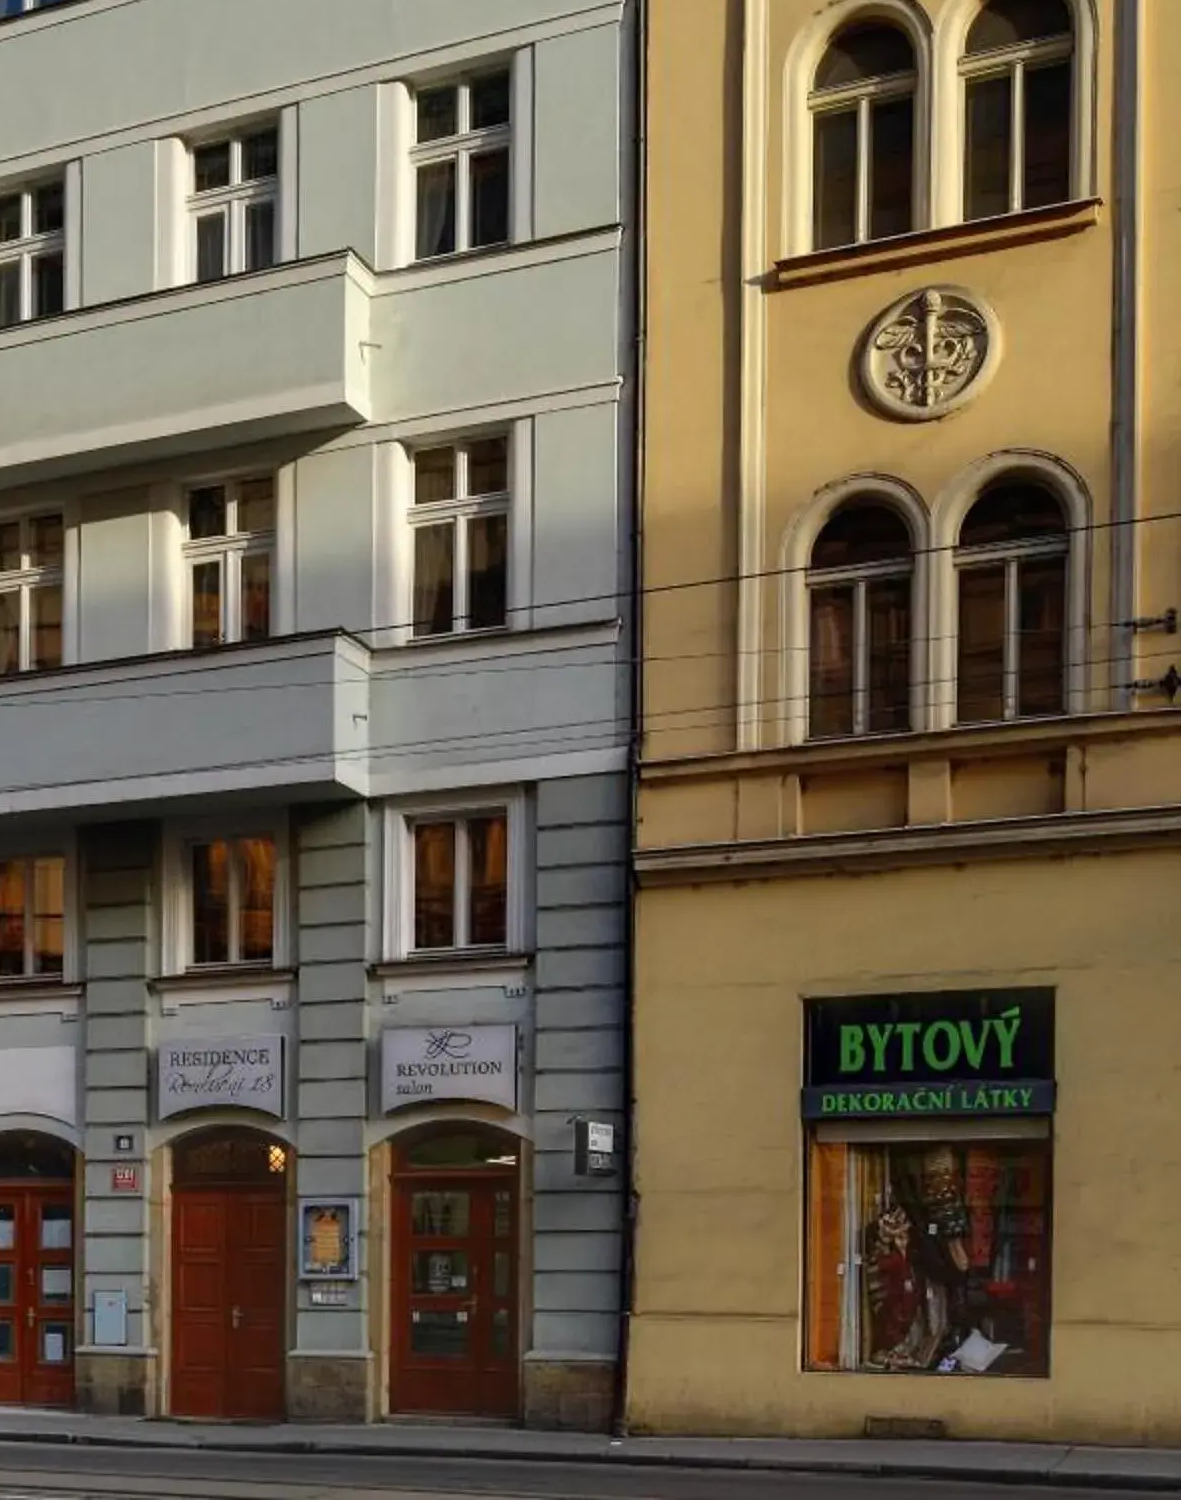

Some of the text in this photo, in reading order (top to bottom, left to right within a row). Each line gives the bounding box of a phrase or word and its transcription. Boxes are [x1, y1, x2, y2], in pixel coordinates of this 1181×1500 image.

[839, 1006, 1021, 1073] BYTOVÝ
[169, 1048, 270, 1068] RESIDENCE
[396, 1060, 503, 1077] REVOLUTION
[395, 1079, 434, 1095] salon
[821, 1083, 1033, 1113] DEKORAČNÍ LÁTKY
